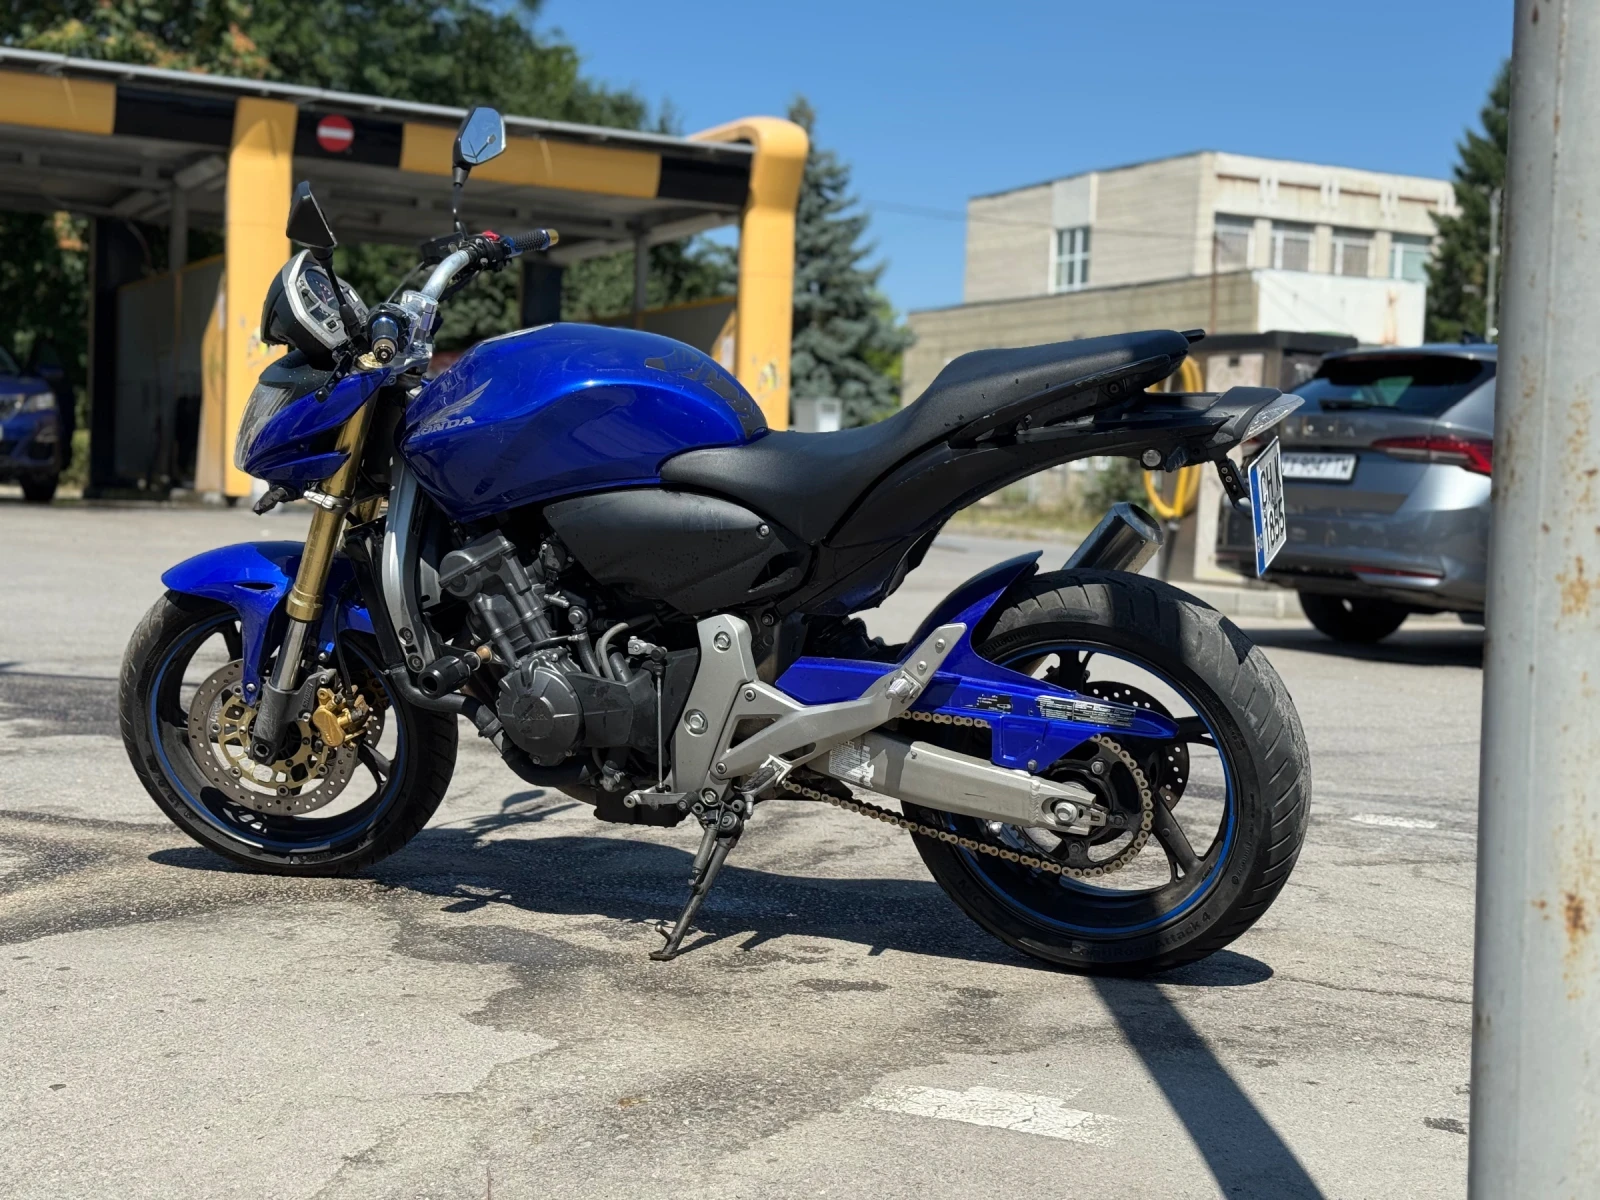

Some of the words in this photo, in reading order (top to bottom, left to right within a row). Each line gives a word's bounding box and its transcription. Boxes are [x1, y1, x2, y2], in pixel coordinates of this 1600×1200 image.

[1260, 462, 1274, 507] CH
[1274, 453, 1282, 491] K
[1264, 497, 1284, 554] 1855
